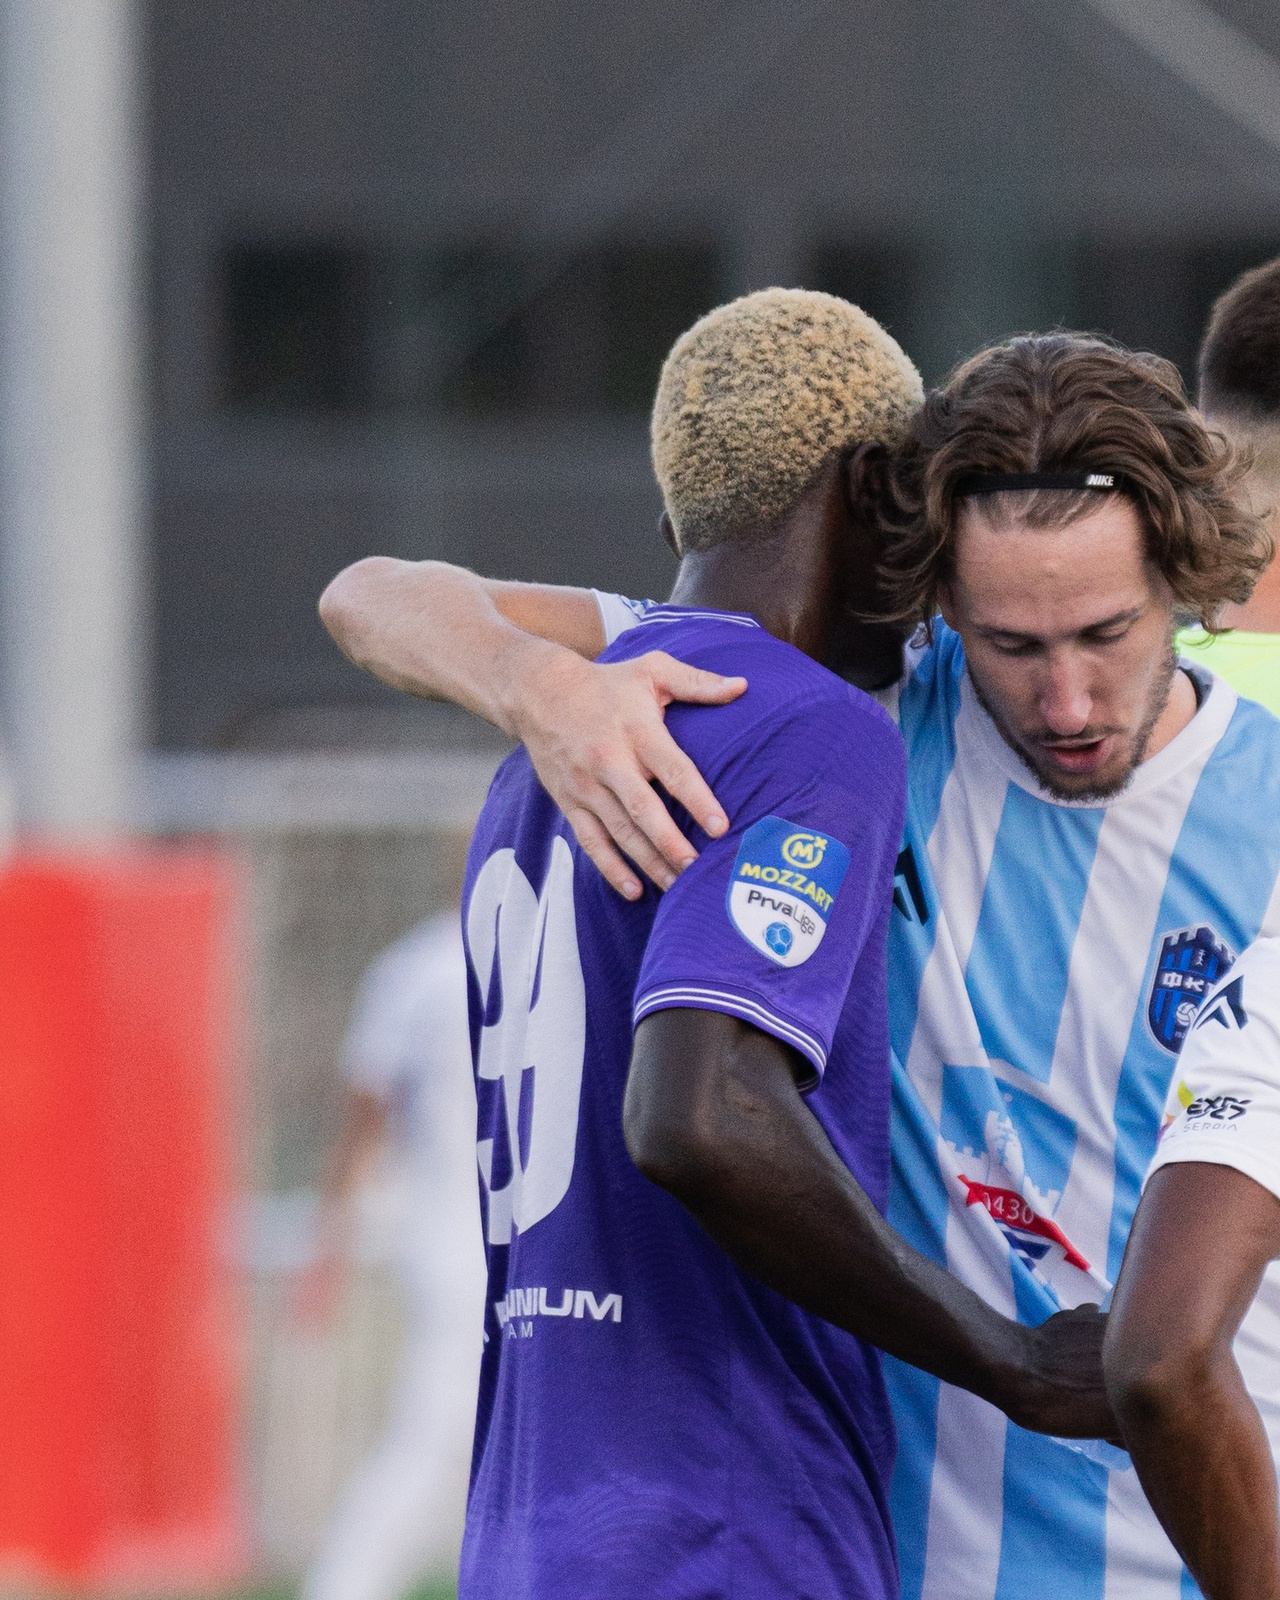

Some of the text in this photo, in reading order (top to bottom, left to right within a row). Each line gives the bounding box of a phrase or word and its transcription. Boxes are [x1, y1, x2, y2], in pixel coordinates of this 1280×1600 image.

[1088, 474, 1114, 486] NIKE
[740, 862, 835, 913] MOZZART
[747, 889, 816, 937] PrvaLiga
[984, 1192, 1035, 1225] 1430
